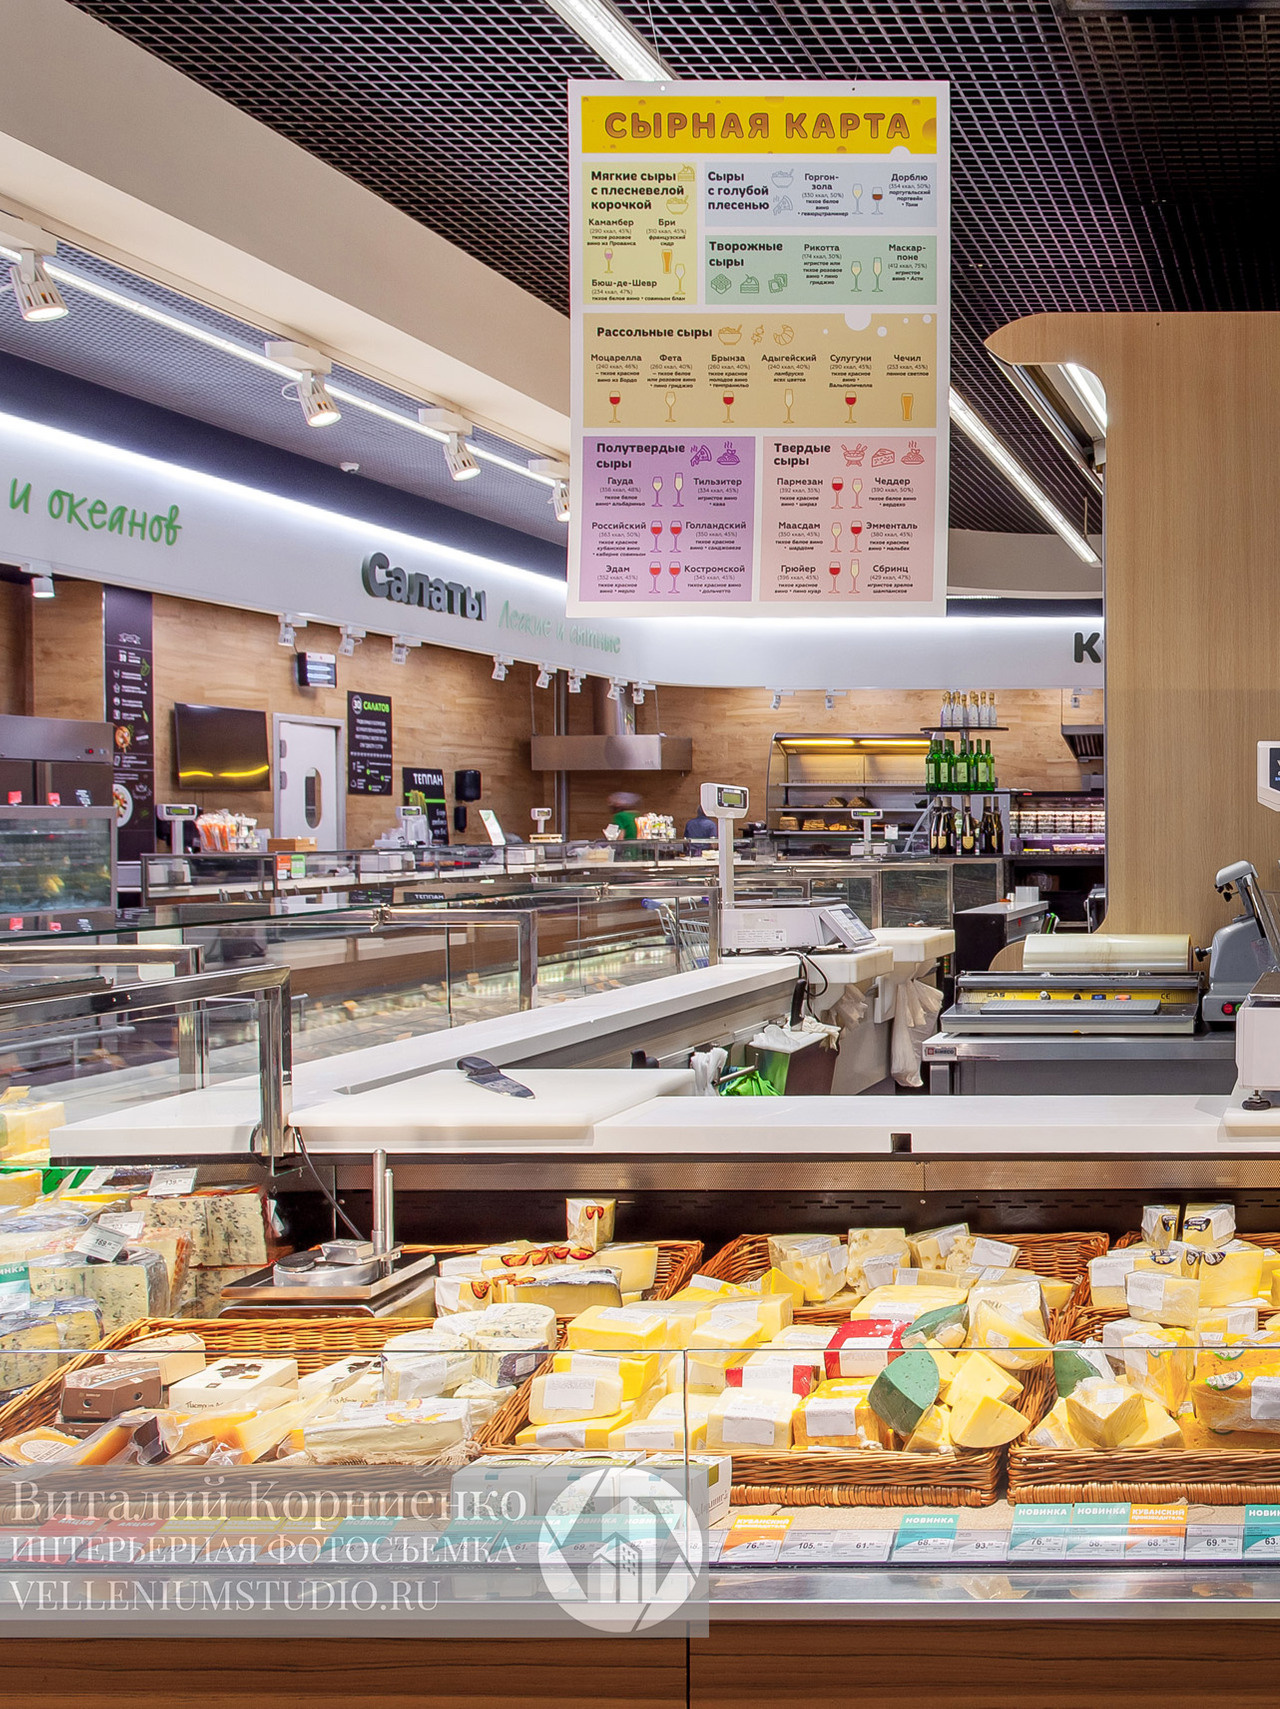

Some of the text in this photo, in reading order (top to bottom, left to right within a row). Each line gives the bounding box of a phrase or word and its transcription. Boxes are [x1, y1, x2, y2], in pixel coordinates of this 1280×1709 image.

[604, 111, 910, 139] СЫРНАЯ КАРТА
[591, 171, 676, 183] Мягкие сыры
[708, 171, 744, 183] Сыры
[804, 173, 839, 183] Горгон-
[891, 173, 928, 182] Дорблю
[591, 185, 684, 195] с плесневелой
[708, 185, 769, 198] с голубой
[591, 200, 652, 211] корочкой
[708, 201, 770, 210] плесенью
[588, 218, 634, 227] Камамбер
[658, 218, 676, 227] Бри
[709, 241, 783, 252] Творожные
[804, 244, 840, 253] Рикотта
[888, 244, 926, 253] Маскар-
[709, 258, 744, 269] сыры
[591, 279, 657, 287] Бюш-де-Шевр
[597, 327, 712, 339] Рассольные сыры
[591, 354, 642, 362] Моцарелла
[659, 354, 682, 362] Фета
[711, 354, 745, 362] Брынза
[761, 354, 817, 362] Адыгейский
[830, 354, 872, 363] Сулугуни
[894, 354, 921, 362] Чечил
[596, 443, 685, 455] Полутвердые
[774, 443, 831, 454] Твердые
[596, 459, 632, 470] сыры
[774, 457, 809, 467] сыры
[607, 477, 634, 486] Гауда
[694, 478, 742, 487] Тильзитер
[776, 478, 823, 486] Пармезан
[874, 477, 910, 486] Чеддер
[9, 477, 183, 546] и океанов
[592, 521, 646, 531] Российский
[686, 521, 746, 531] Голландский
[778, 522, 821, 531] Маасдам
[866, 522, 918, 530] Эмменталь
[606, 565, 630, 574] Эдам
[684, 565, 745, 574] Костромской
[781, 565, 816, 574] Грюйер
[873, 565, 909, 574] Сбринц
[361, 552, 487, 621] Салаты
[498, 600, 621, 654] Легкие и сытные
[363, 700, 390, 713] САЛАТОВ
[413, 773, 443, 786] ТЕППАН
[1018, 1508, 1068, 1516] НОВИНКА
[1077, 1507, 1127, 1515] НОВИНКА
[1132, 1508, 1185, 1516] КУБАНСКИЙ
[568, 1517, 618, 1526] НОВИНКА
[1206, 1539, 1220, 1547] 69.
[1264, 1537, 1279, 1545] 63.
